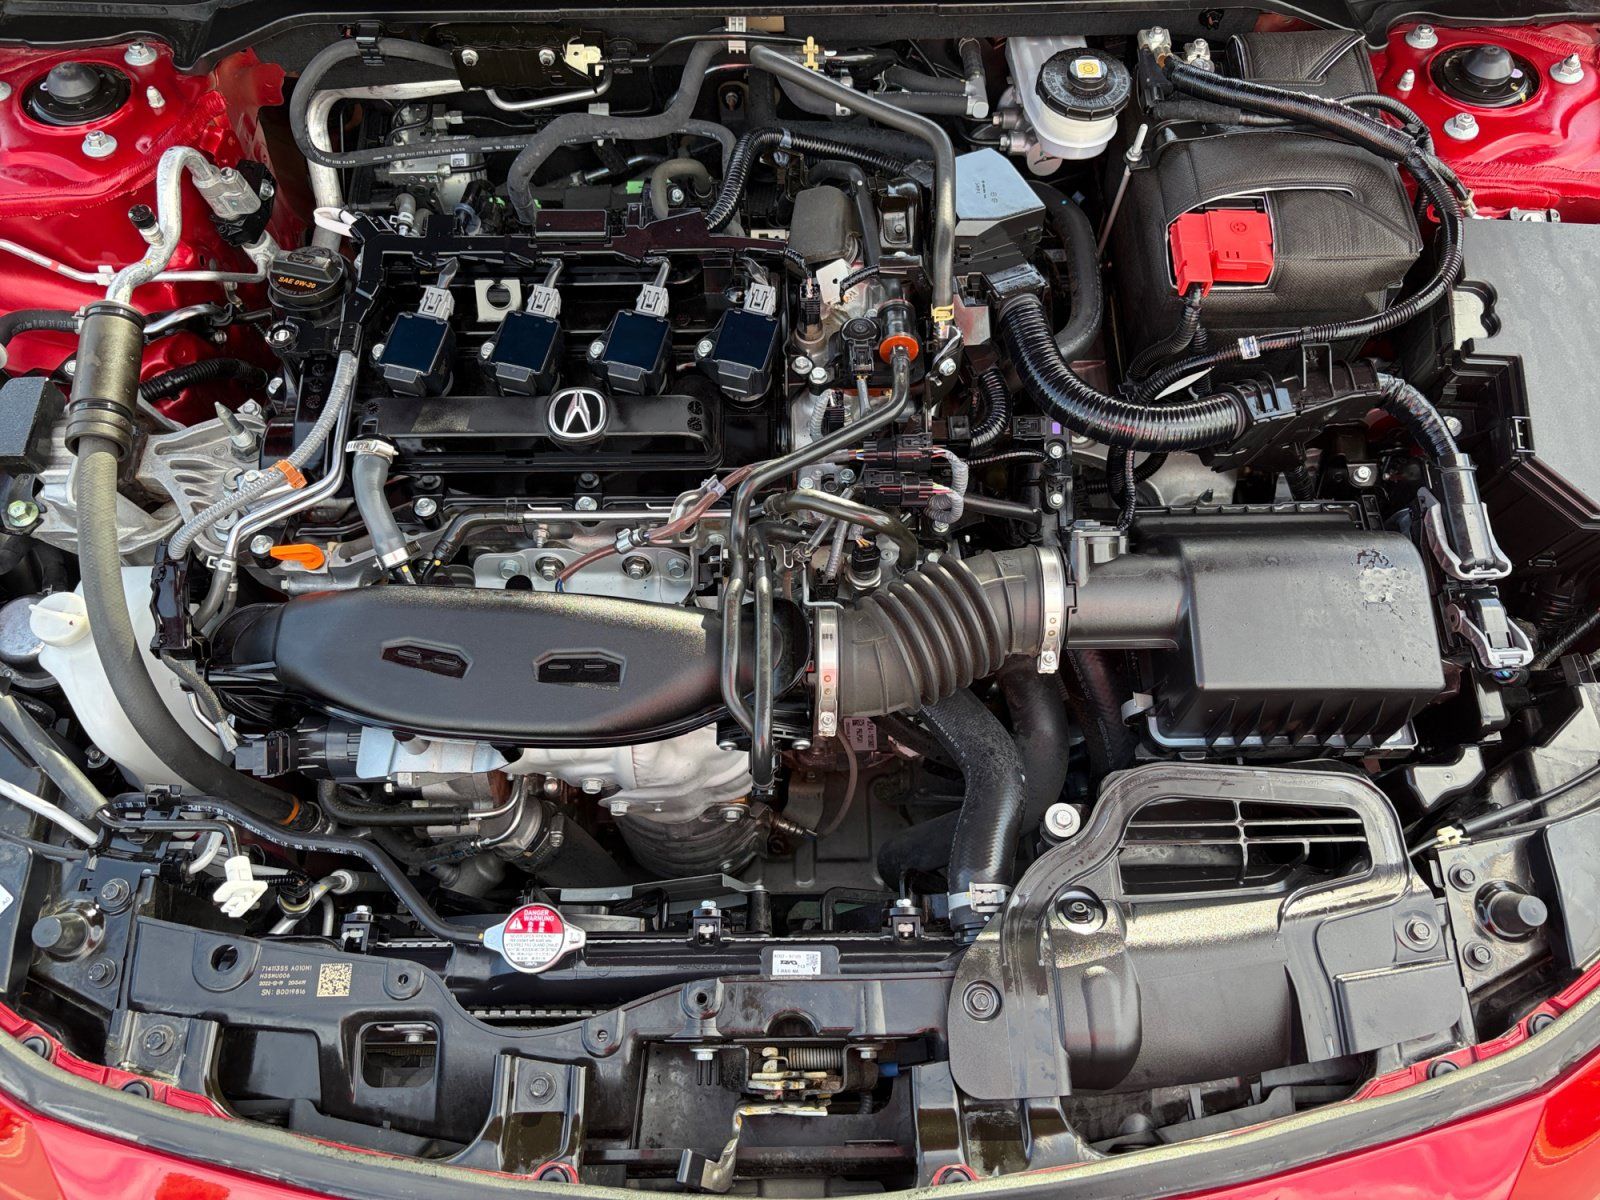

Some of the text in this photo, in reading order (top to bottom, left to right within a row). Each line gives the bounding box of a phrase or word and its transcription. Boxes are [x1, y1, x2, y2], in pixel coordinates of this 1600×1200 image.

[278, 276, 317, 289] SAE 0W-20
[262, 988, 274, 996] SN:
